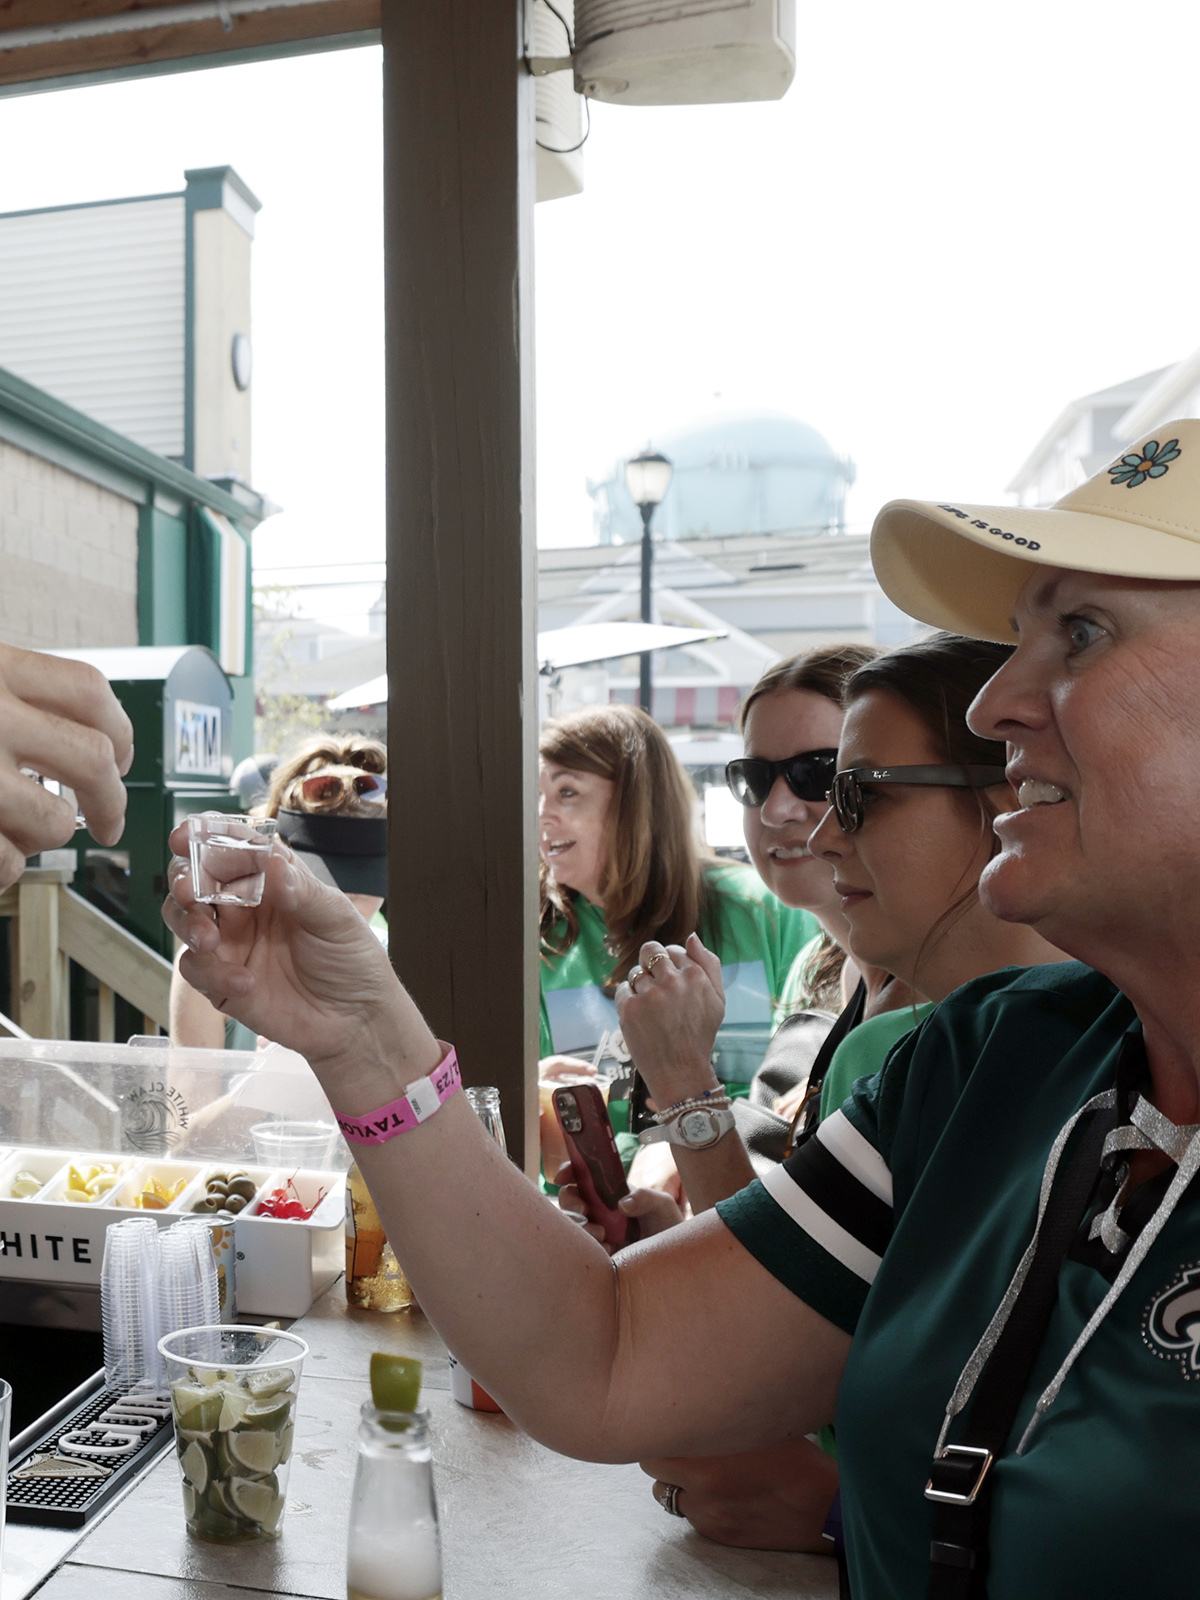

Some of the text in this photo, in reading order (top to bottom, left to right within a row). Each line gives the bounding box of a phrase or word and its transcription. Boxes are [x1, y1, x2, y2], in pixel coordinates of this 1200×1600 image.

[937, 503, 1041, 551] LIFE IS GOOD
[178, 711, 219, 768] ATM
